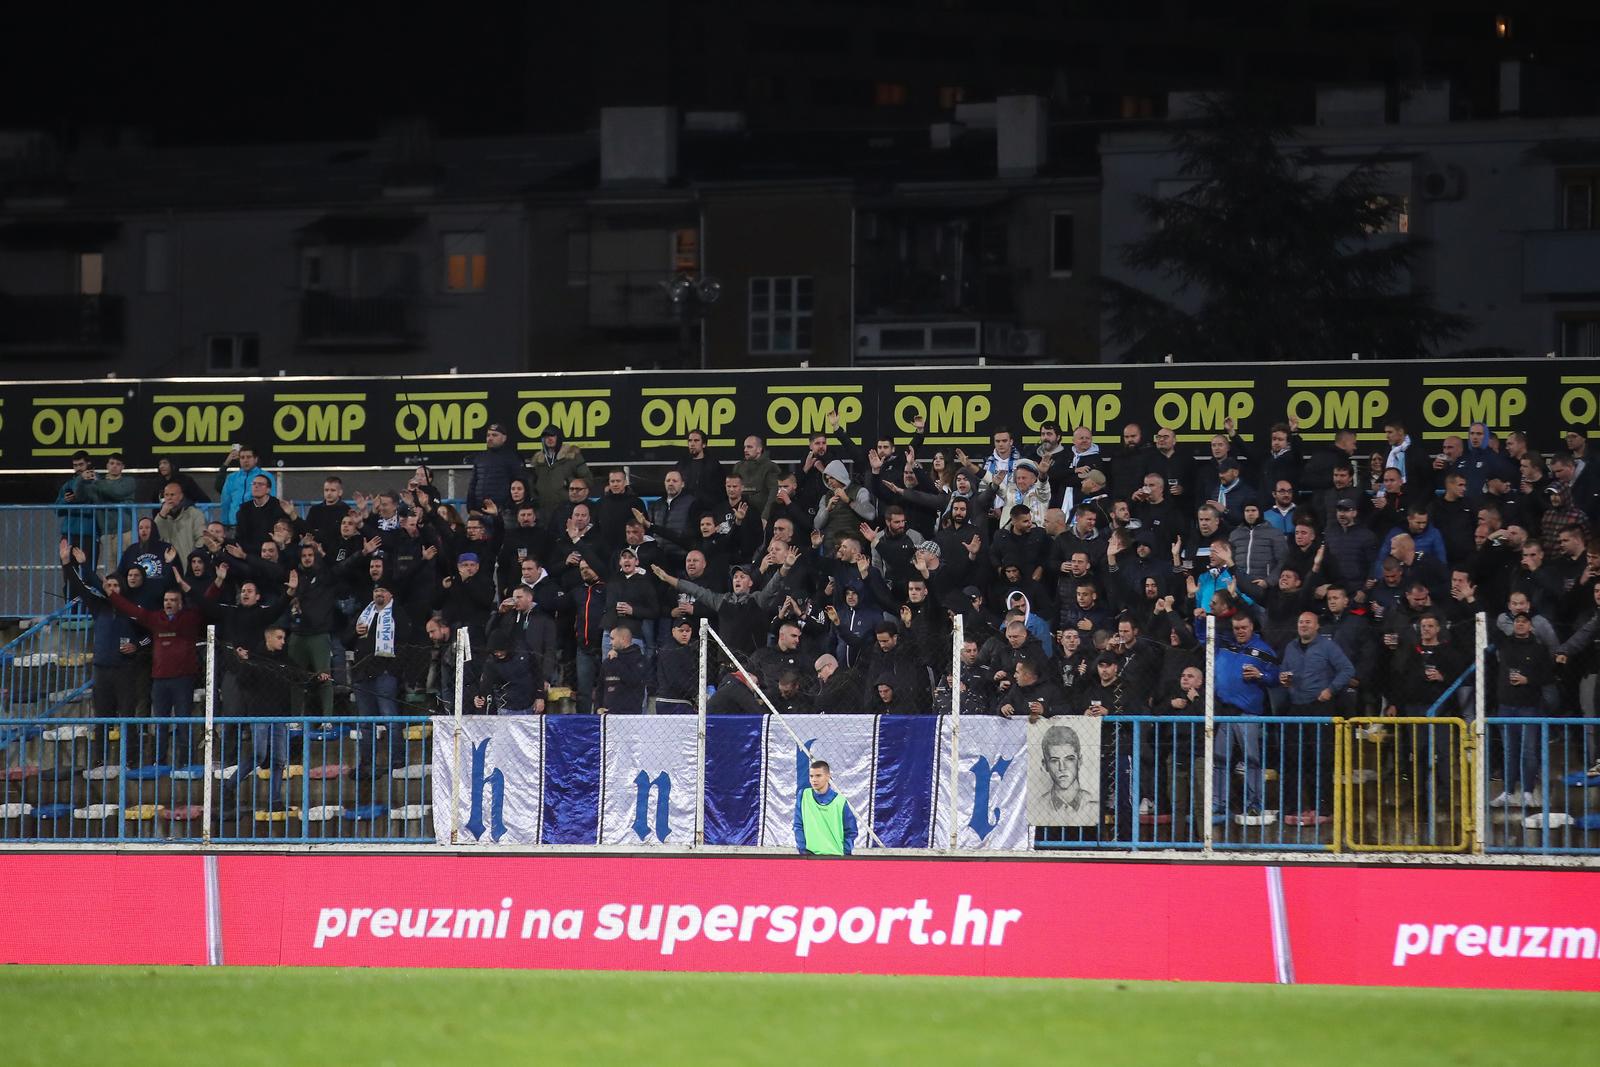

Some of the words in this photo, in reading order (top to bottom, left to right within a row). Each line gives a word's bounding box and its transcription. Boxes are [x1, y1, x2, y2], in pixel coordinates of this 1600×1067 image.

[32, 407, 124, 445] OMP
[153, 405, 244, 442] OMP
[273, 404, 366, 441] OMP
[395, 403, 488, 440] OMP
[517, 401, 611, 439] OMP
[641, 398, 737, 436] OMP
[766, 396, 863, 434] OMP
[894, 394, 991, 433] OMP
[1023, 394, 1121, 432] OMP
[1154, 391, 1254, 431] OMP
[1287, 389, 1389, 429] OMP
[1423, 387, 1527, 427] OMP
[1560, 386, 1600, 425] O
[313, 896, 512, 949] preuzmi
[520, 908, 585, 940] na
[593, 894, 1023, 958] supersport.hr
[1392, 922, 1600, 967] preuzm
